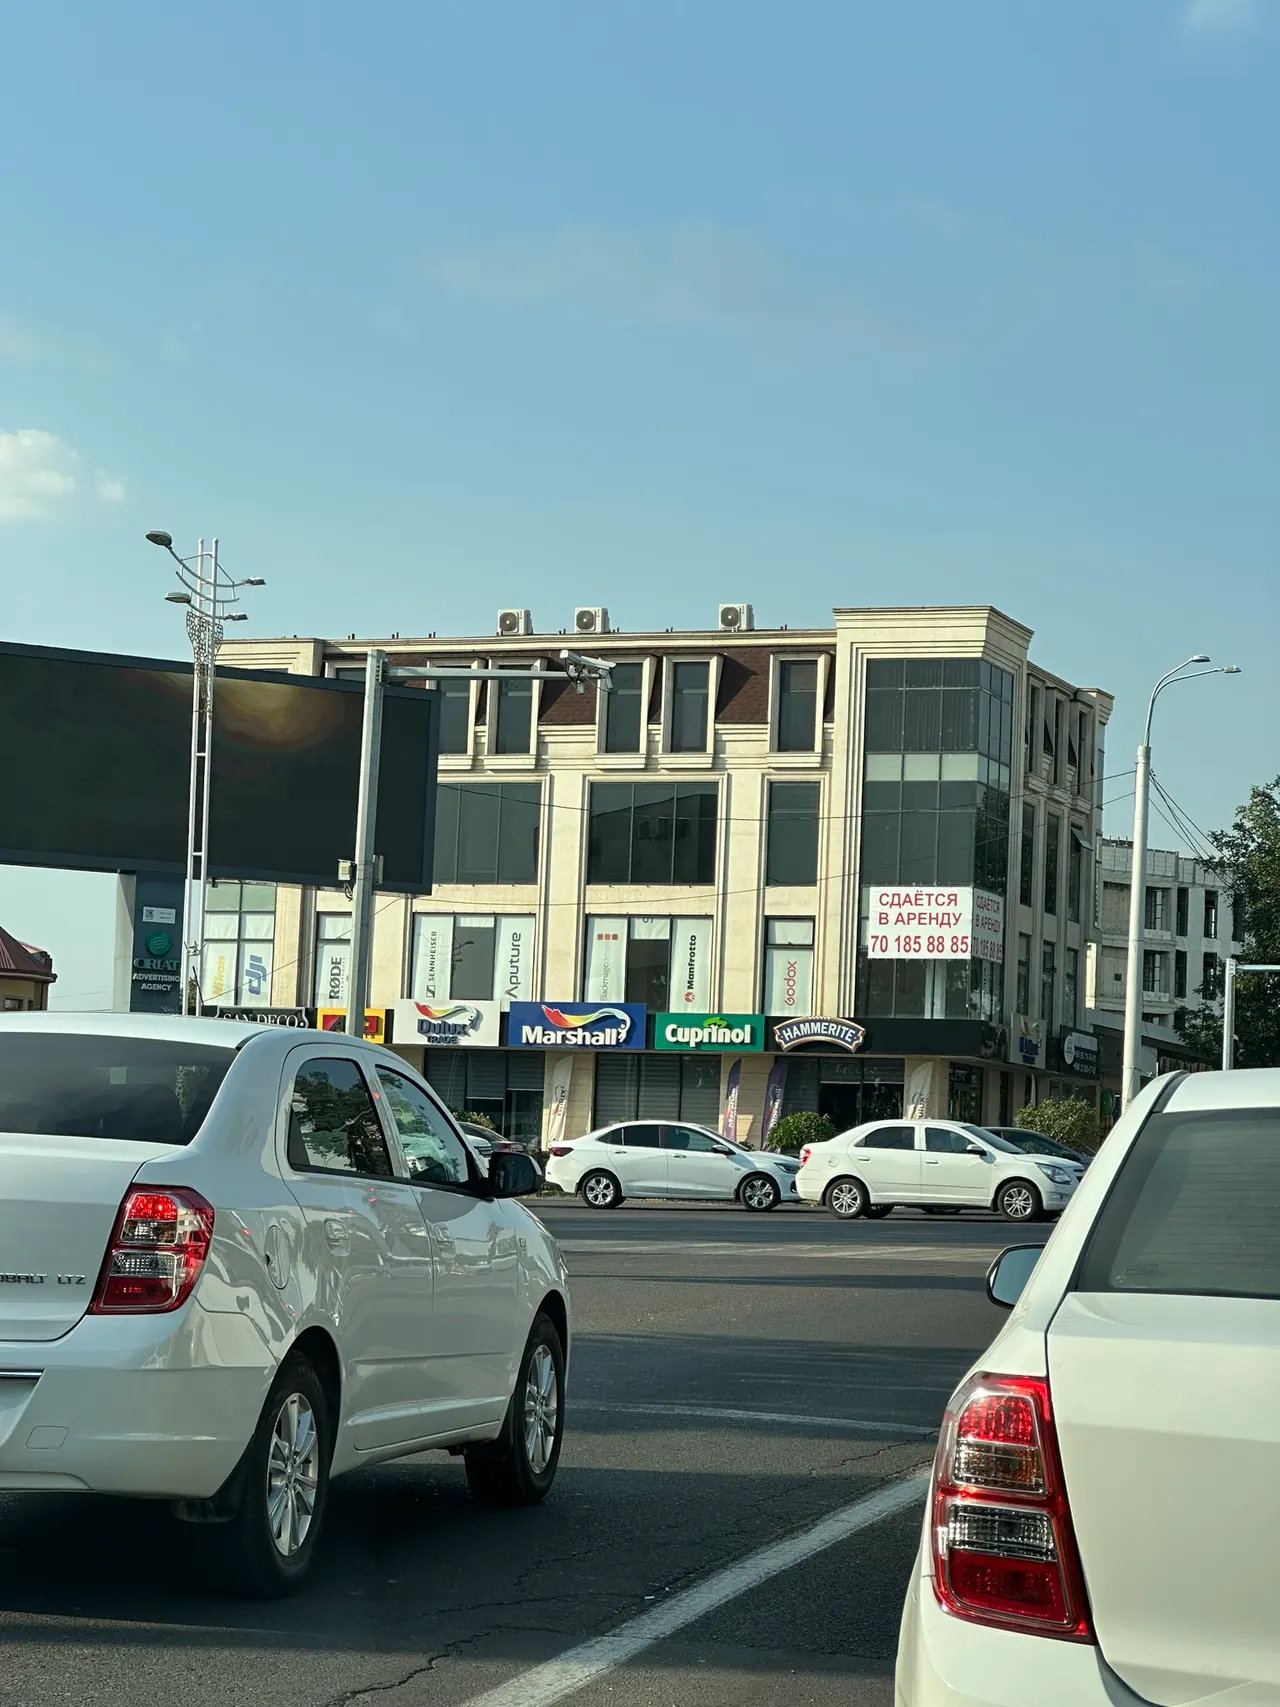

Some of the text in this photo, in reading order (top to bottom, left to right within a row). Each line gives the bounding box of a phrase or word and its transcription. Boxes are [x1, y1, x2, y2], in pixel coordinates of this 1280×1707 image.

[879, 890, 958, 908] СДАЁТСЯ
[878, 913, 962, 928] В АРЕНДУ
[871, 935, 969, 953] 70 185 88 85
[429, 931, 438, 982] SENNHEISER
[505, 932, 522, 998] Aputure
[687, 935, 697, 990] Manfrotto
[132, 973, 180, 983] ADVERTISING
[141, 983, 172, 992] AGENCY
[329, 957, 342, 1000] RØDE
[418, 1019, 469, 1036] Dulux
[522, 1025, 618, 1046] Marshall
[665, 1024, 751, 1047] Cuprinol
[782, 1022, 857, 1043] HAMMERITE
[427, 1035, 459, 1044] TRADE
[917, 1097, 925, 1119] ulux
[57, 1274, 86, 1284] LTZ
